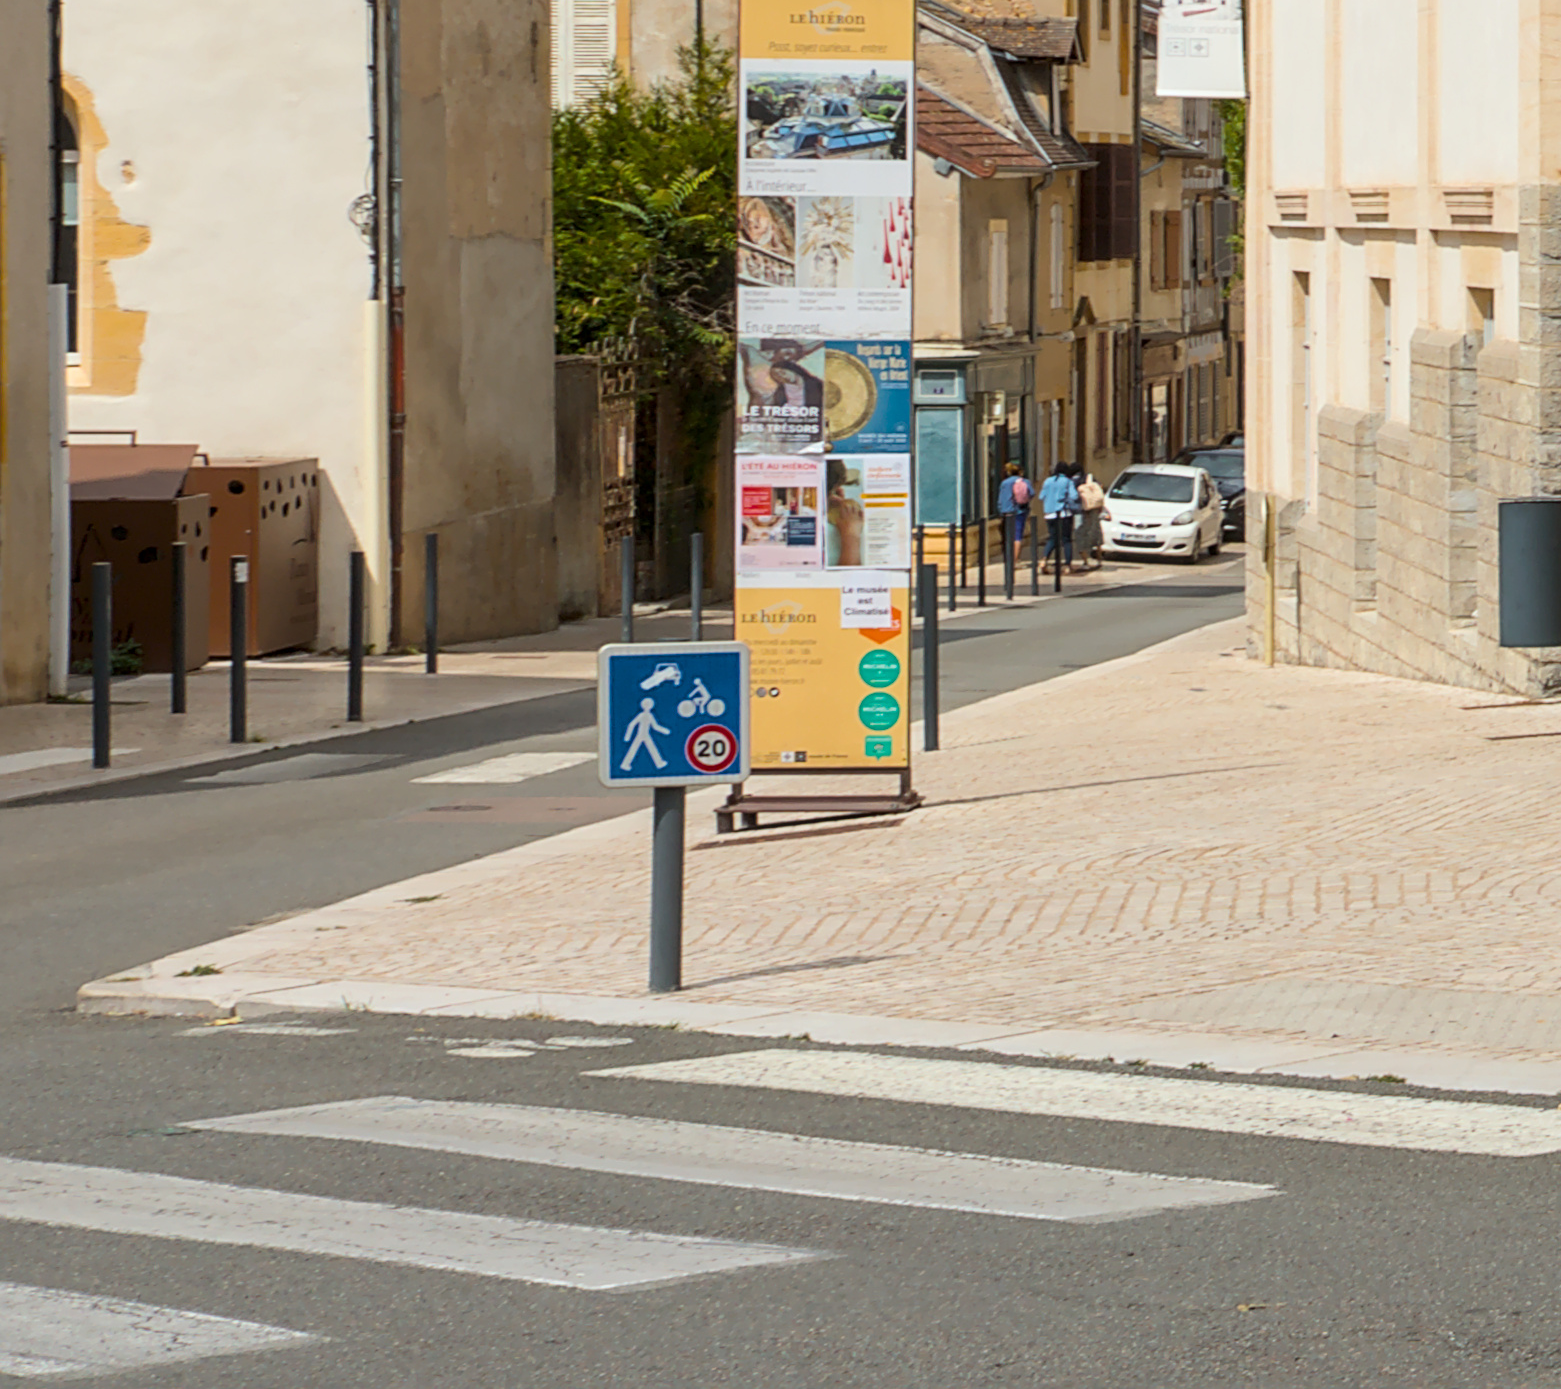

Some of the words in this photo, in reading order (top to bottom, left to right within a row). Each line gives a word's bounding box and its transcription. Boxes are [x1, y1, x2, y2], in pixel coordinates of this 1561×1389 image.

[746, 322, 759, 334] En
[761, 324, 773, 334] ce
[742, 406, 759, 416] LE
[742, 424, 764, 433] DES
[767, 422, 819, 434] TRÉSORS
[782, 461, 817, 470] HIÉRON
[842, 586, 854, 594] Le
[856, 585, 889, 594] musée
[844, 607, 889, 616] Climatisé
[697, 739, 726, 757] 20
